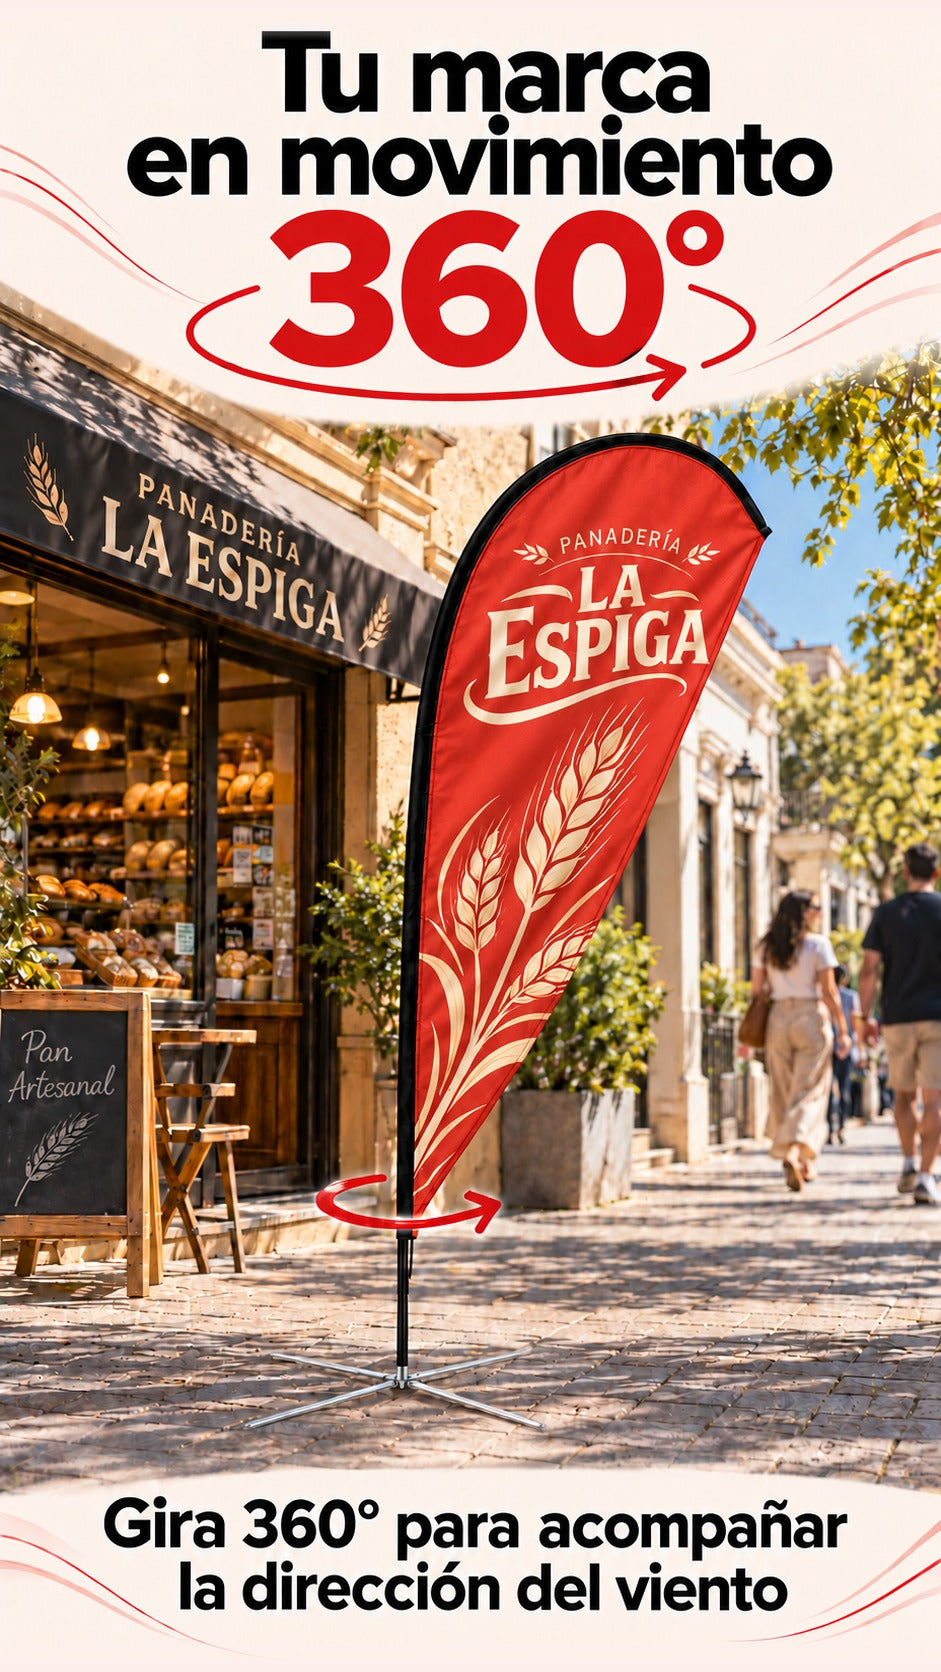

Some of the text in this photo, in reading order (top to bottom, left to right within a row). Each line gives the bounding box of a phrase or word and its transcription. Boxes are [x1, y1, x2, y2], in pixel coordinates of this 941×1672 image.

[139, 472, 301, 566] PANADERÍA
[560, 528, 681, 554] PANADERÍA
[101, 496, 345, 643] LA ESPIGA
[578, 564, 646, 613] LA
[484, 606, 710, 699] ESPIGA
[21, 1029, 73, 1064] Pan
[8, 1064, 116, 1103] Artesanal
